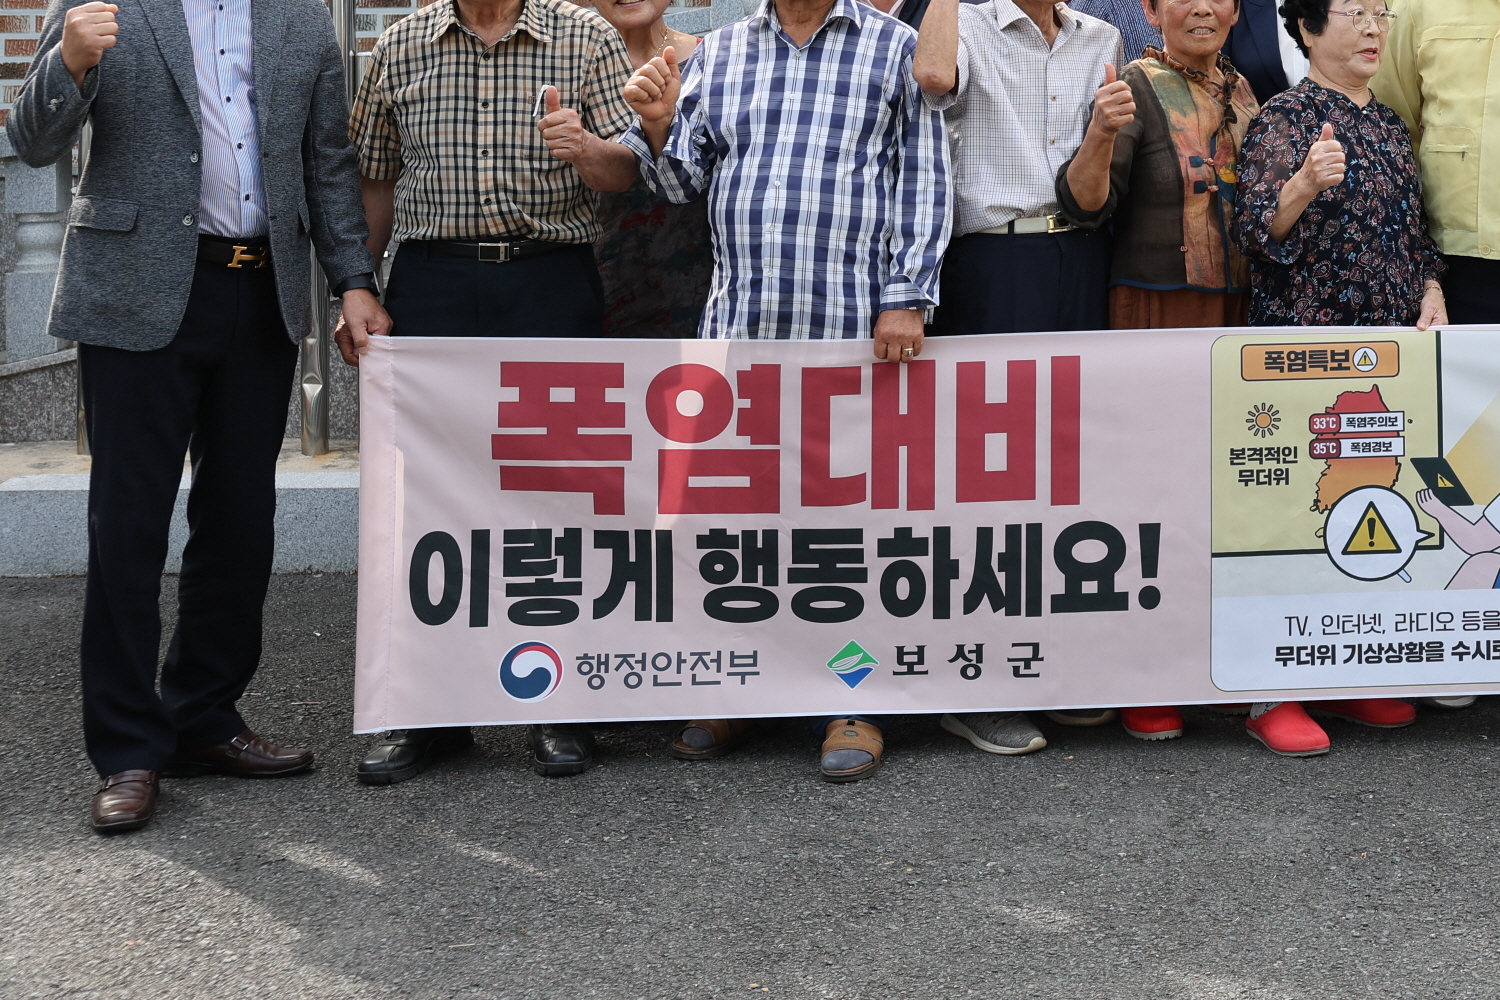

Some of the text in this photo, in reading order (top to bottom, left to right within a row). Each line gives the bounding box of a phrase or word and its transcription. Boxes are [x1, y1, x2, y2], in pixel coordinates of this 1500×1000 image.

[1263, 348, 1352, 374] 폭염특보
[1345, 415, 1399, 429] 폭염주의보
[491, 355, 1081, 516] 폭염대비
[1350, 440, 1393, 454] 폭염경보
[1229, 445, 1299, 466] 본격적인
[1237, 468, 1290, 488] 무더위
[408, 520, 1163, 628] 이렇게 행동하세요!
[1284, 615, 1313, 637] TV,
[1321, 613, 1386, 636] 인터넷,
[1394, 611, 1455, 634] 라디오
[1274, 644, 1336, 667] 무더위
[1343, 641, 1445, 665] 기상상황을
[575, 648, 761, 690] 행정안전부
